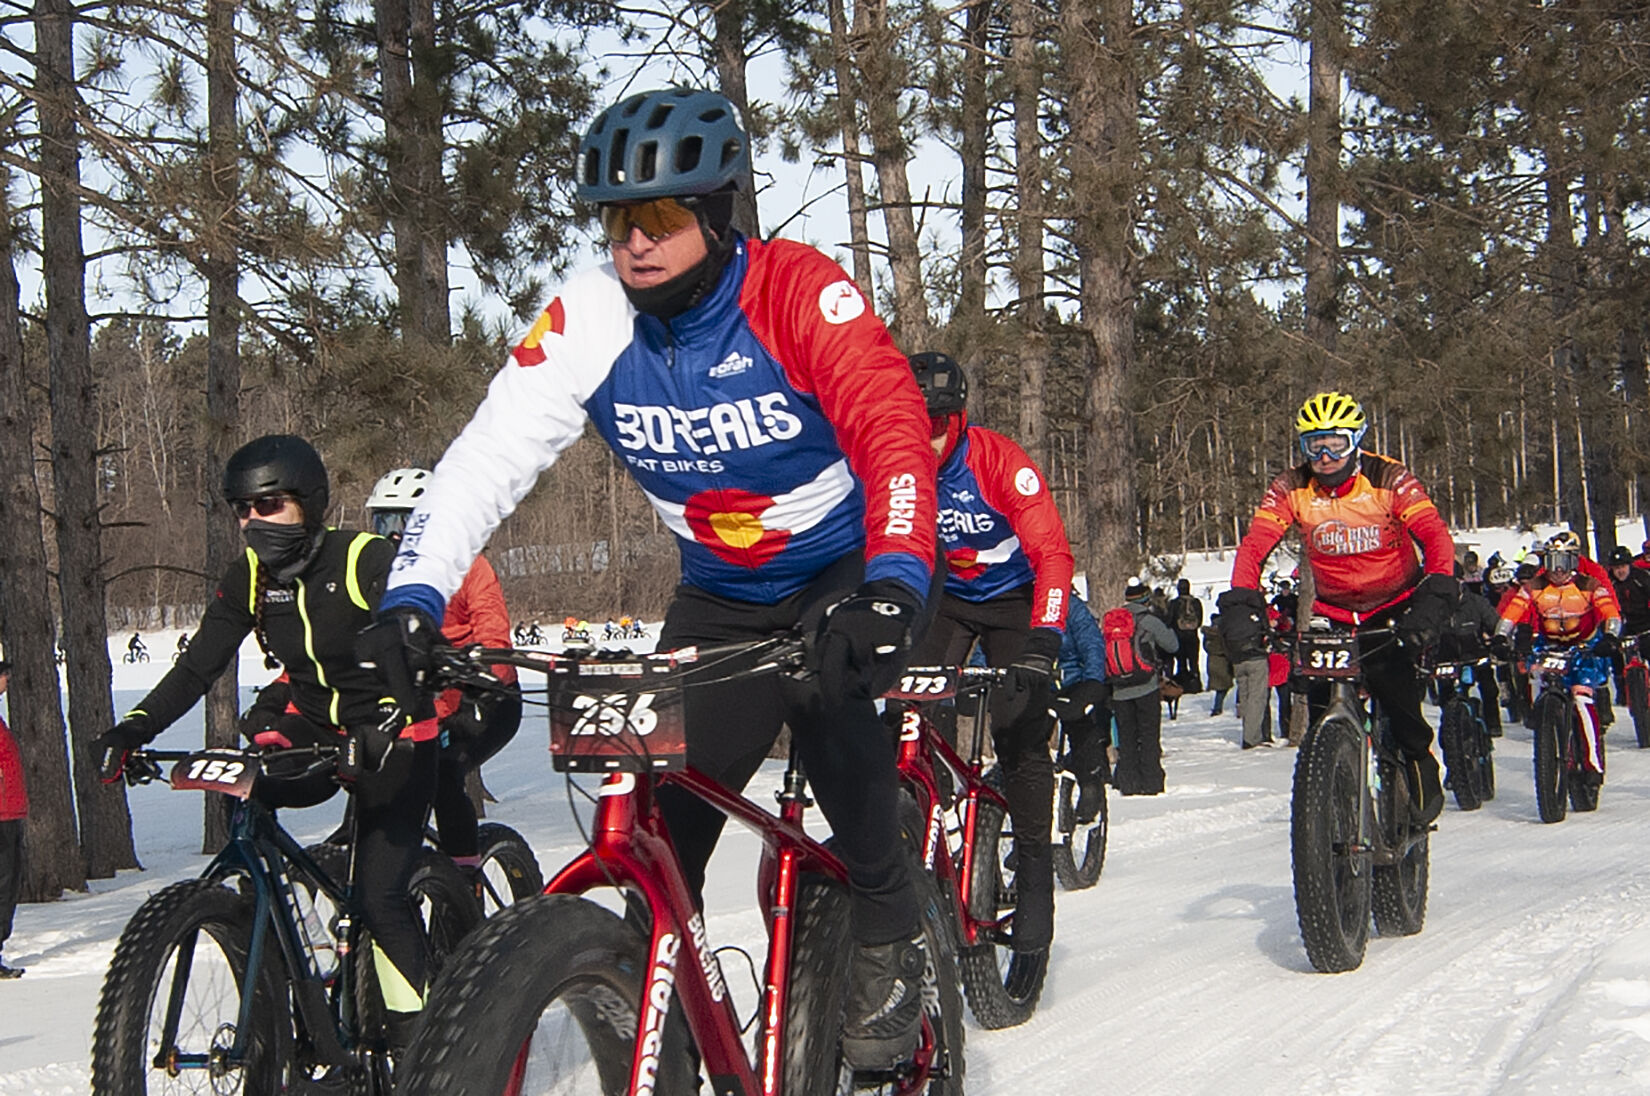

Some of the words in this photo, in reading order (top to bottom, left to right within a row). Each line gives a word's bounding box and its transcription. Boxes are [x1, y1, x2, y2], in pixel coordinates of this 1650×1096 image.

[614, 392, 802, 455] BOREALS
[626, 455, 659, 472] FAT
[662, 460, 725, 473] BIKES
[1321, 530, 1346, 547] BIG
[1347, 524, 1380, 543] RING
[1311, 649, 1350, 669] 312
[901, 676, 947, 693] 173
[570, 694, 658, 736] 256
[188, 759, 244, 784] 152
